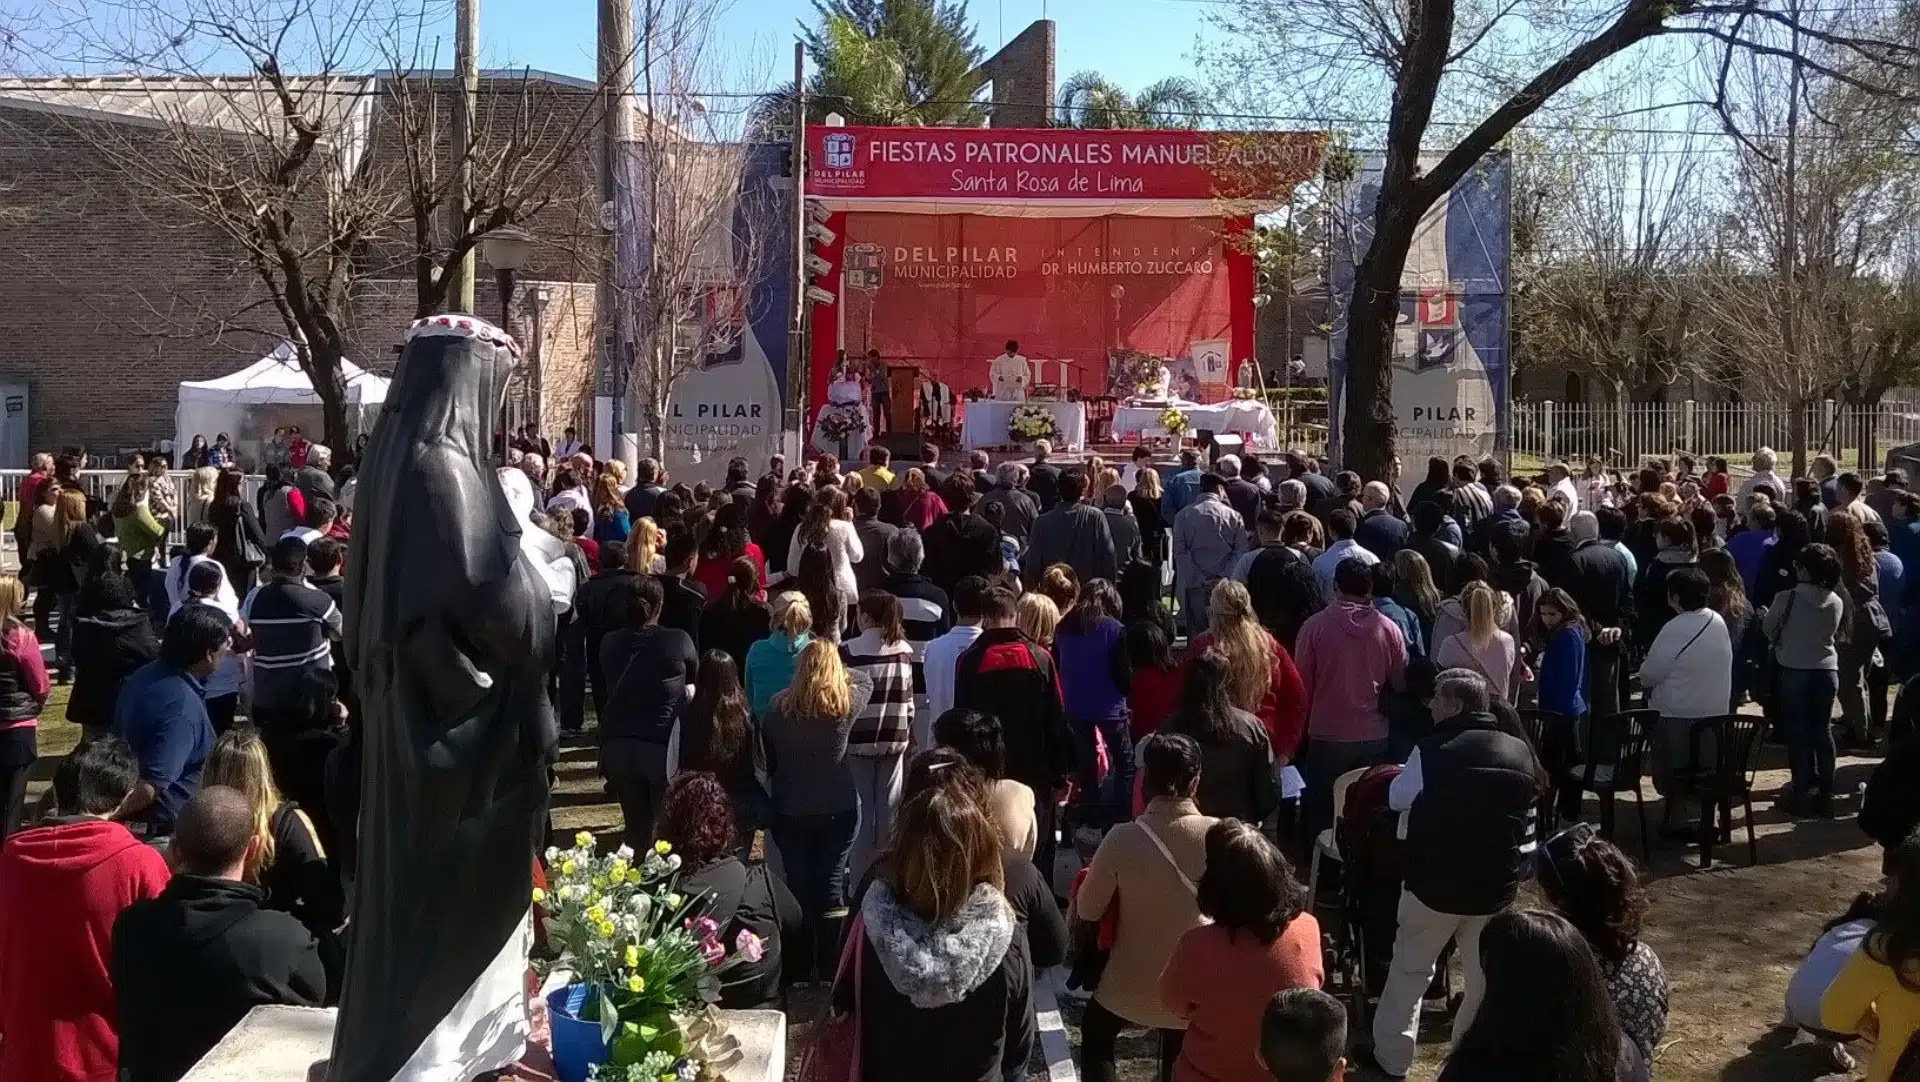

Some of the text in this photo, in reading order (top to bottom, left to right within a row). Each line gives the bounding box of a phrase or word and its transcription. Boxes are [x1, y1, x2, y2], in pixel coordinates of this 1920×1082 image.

[869, 141, 956, 163] FIESTAS
[965, 142, 1113, 164] PATRONALES
[813, 170, 866, 178] DEL PILAR
[951, 168, 1144, 193] Santa Rosa de Lima
[894, 246, 1018, 263] DEL PILAR
[1041, 247, 1213, 257] INTENDENTE
[894, 265, 1018, 279] MUNICIPALIDAD
[1042, 260, 1213, 275] DR HUMBERTO ZUCCARO
[698, 403, 762, 418] PILAR
[1413, 406, 1476, 421] PILAR
[667, 423, 761, 436] NICIPALIDAD
